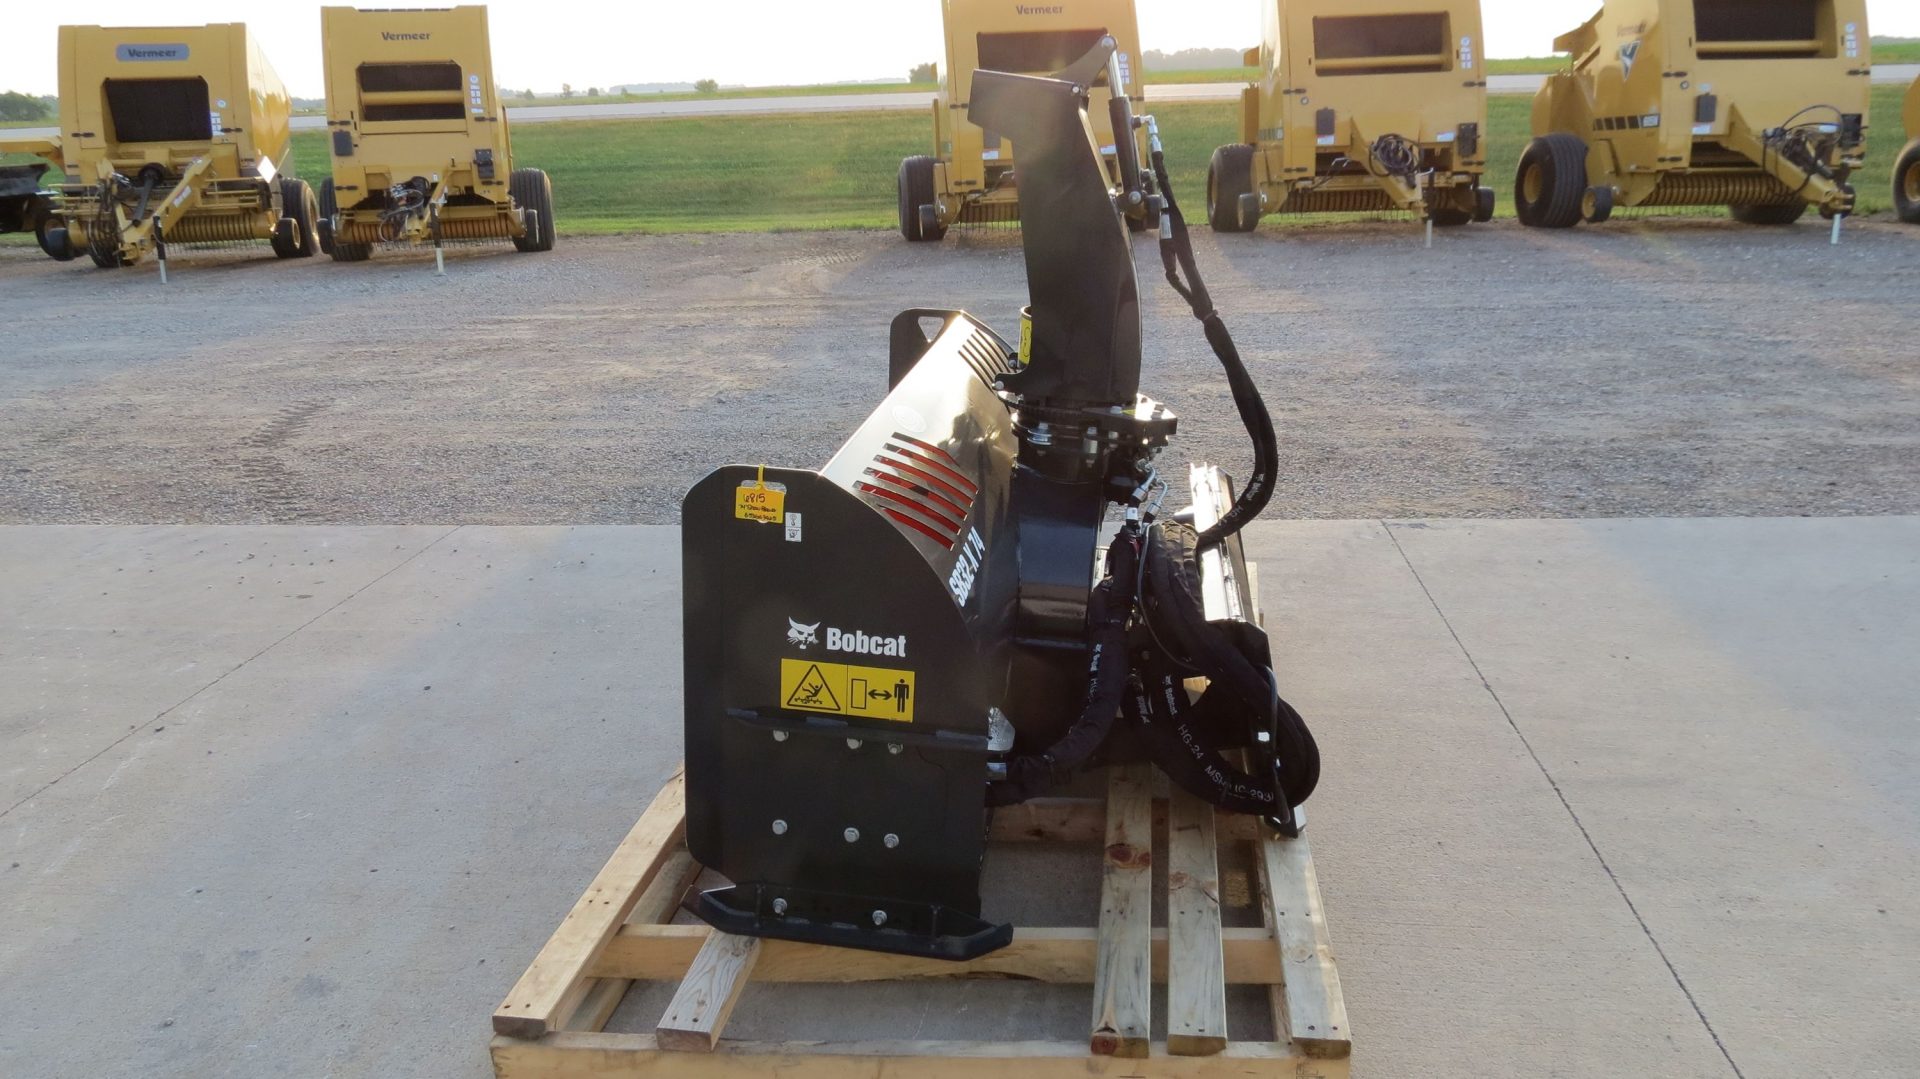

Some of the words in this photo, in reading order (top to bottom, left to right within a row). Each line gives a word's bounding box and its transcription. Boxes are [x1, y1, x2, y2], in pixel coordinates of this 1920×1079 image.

[1016, 5, 1063, 15] Vermeer
[382, 32, 431, 41] Vermeer
[128, 48, 177, 57] Vermeer
[949, 554, 975, 607] SB32
[968, 526, 985, 560] 74
[827, 627, 906, 657] Bobcat
[1178, 724, 1204, 759] HG-24
